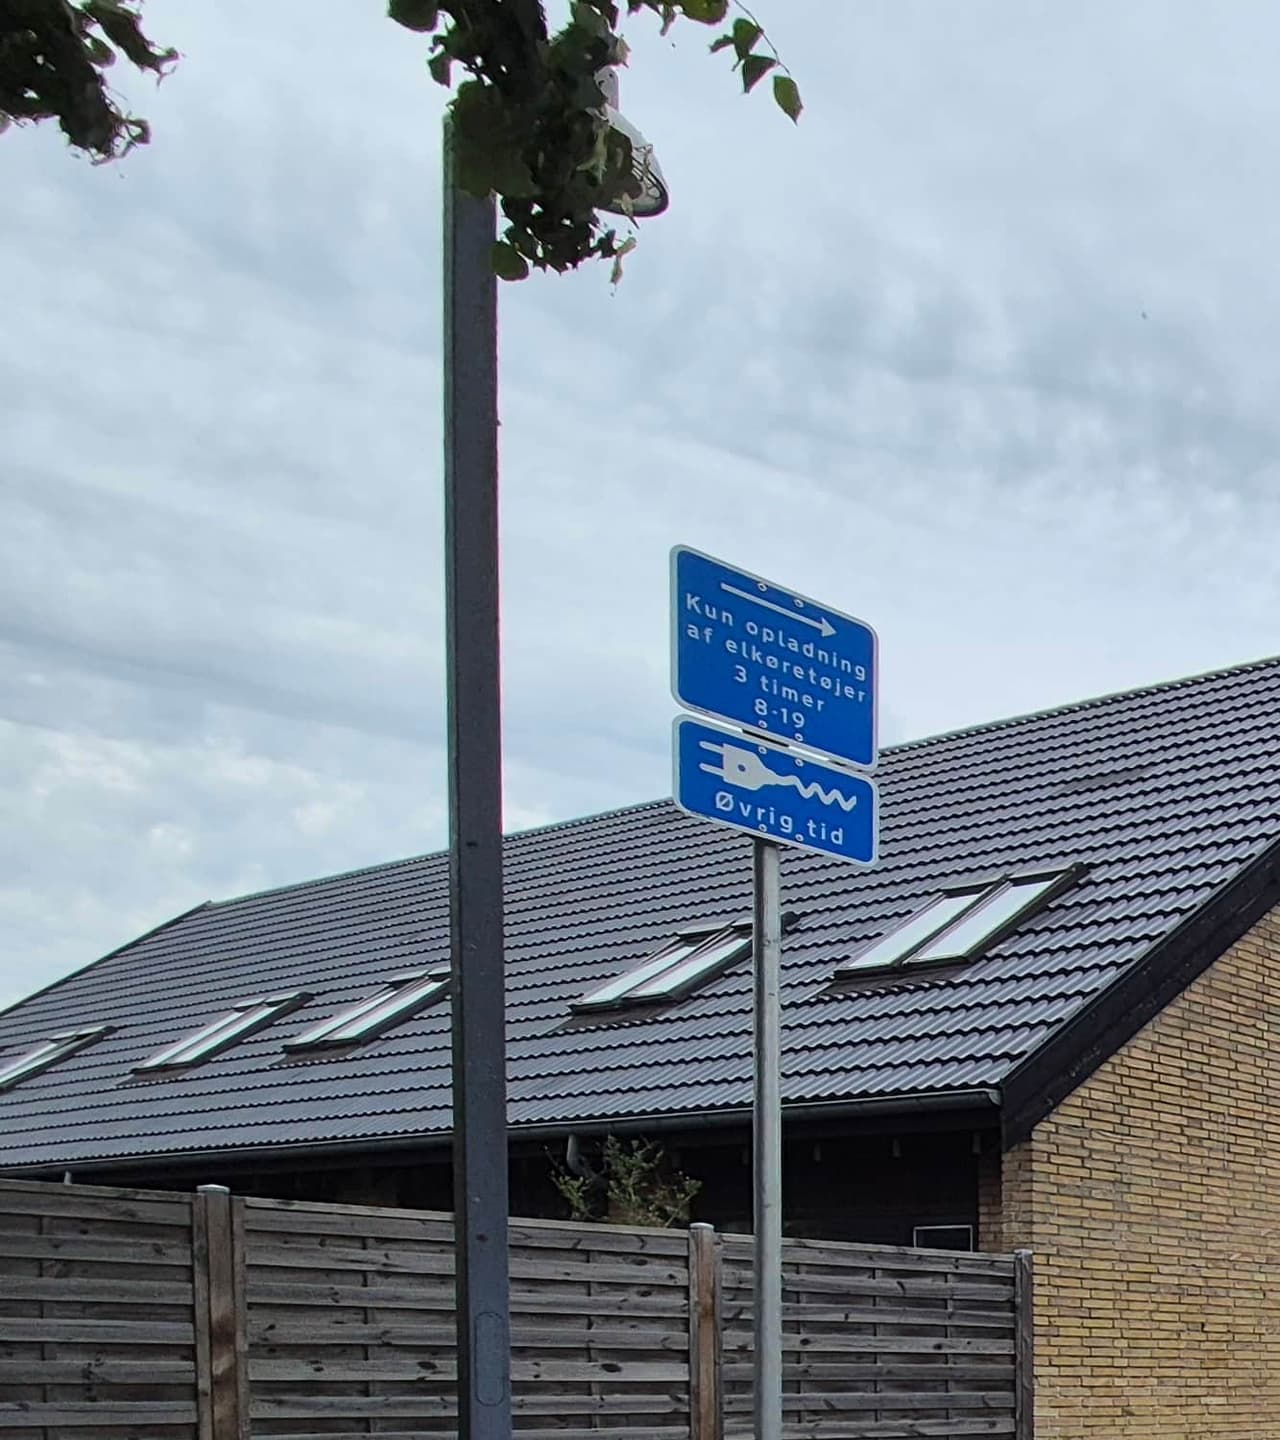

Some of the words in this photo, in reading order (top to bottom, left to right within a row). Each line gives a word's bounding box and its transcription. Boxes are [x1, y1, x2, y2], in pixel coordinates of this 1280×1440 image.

[686, 593, 734, 626] Kun
[746, 621, 867, 681] opladning
[687, 624, 713, 644] af
[725, 639, 866, 703] elkøretøjer
[733, 664, 748, 683] 3
[760, 675, 825, 712] timer
[754, 698, 806, 729] 8-19
[715, 791, 793, 833] Øvrig
[807, 819, 844, 845] tid
